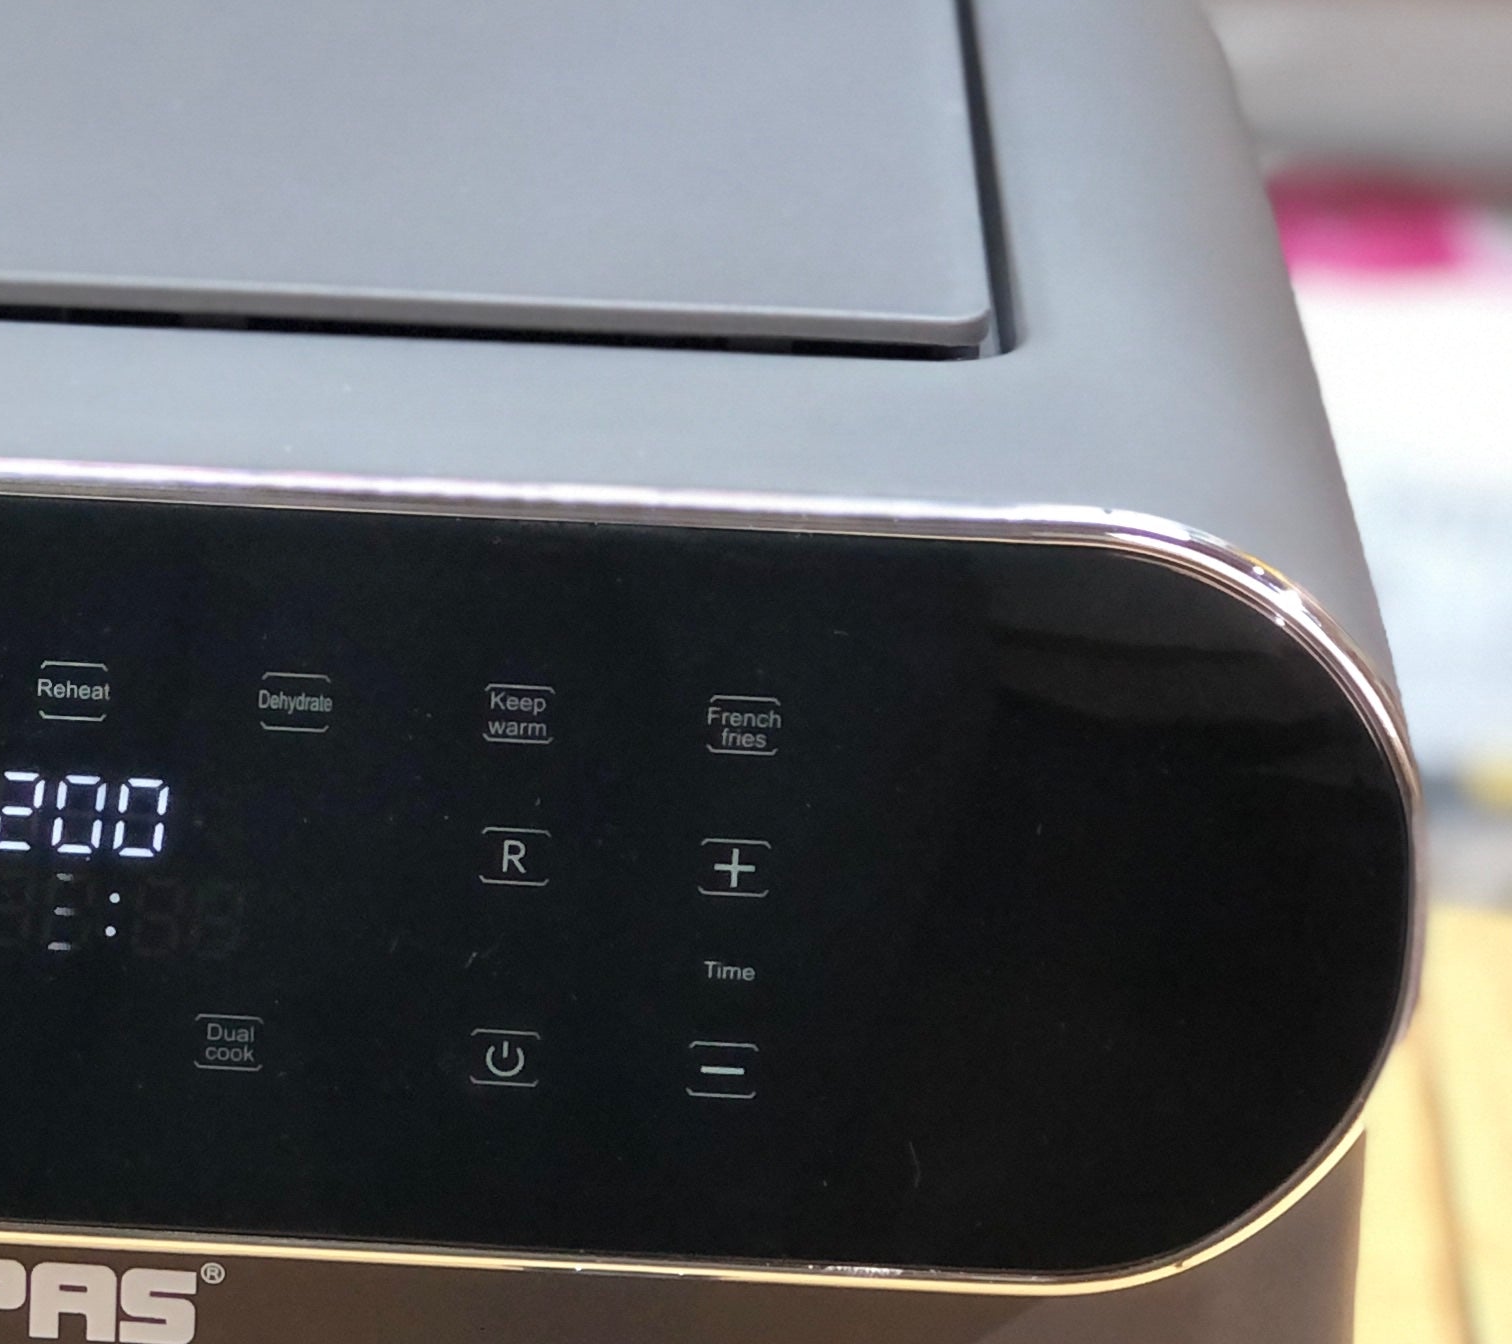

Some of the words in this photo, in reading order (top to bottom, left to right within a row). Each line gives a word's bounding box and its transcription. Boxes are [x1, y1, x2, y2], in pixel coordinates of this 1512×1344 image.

[38, 679, 109, 699] Reheat
[259, 690, 332, 714] Dehydrate
[491, 692, 546, 714] Keep
[708, 707, 781, 730] French
[488, 721, 547, 738] warm
[721, 730, 767, 749] fries
[503, 840, 526, 873] R
[704, 961, 755, 980] Time
[207, 1023, 254, 1042] Dual
[206, 1045, 254, 1061] cook
